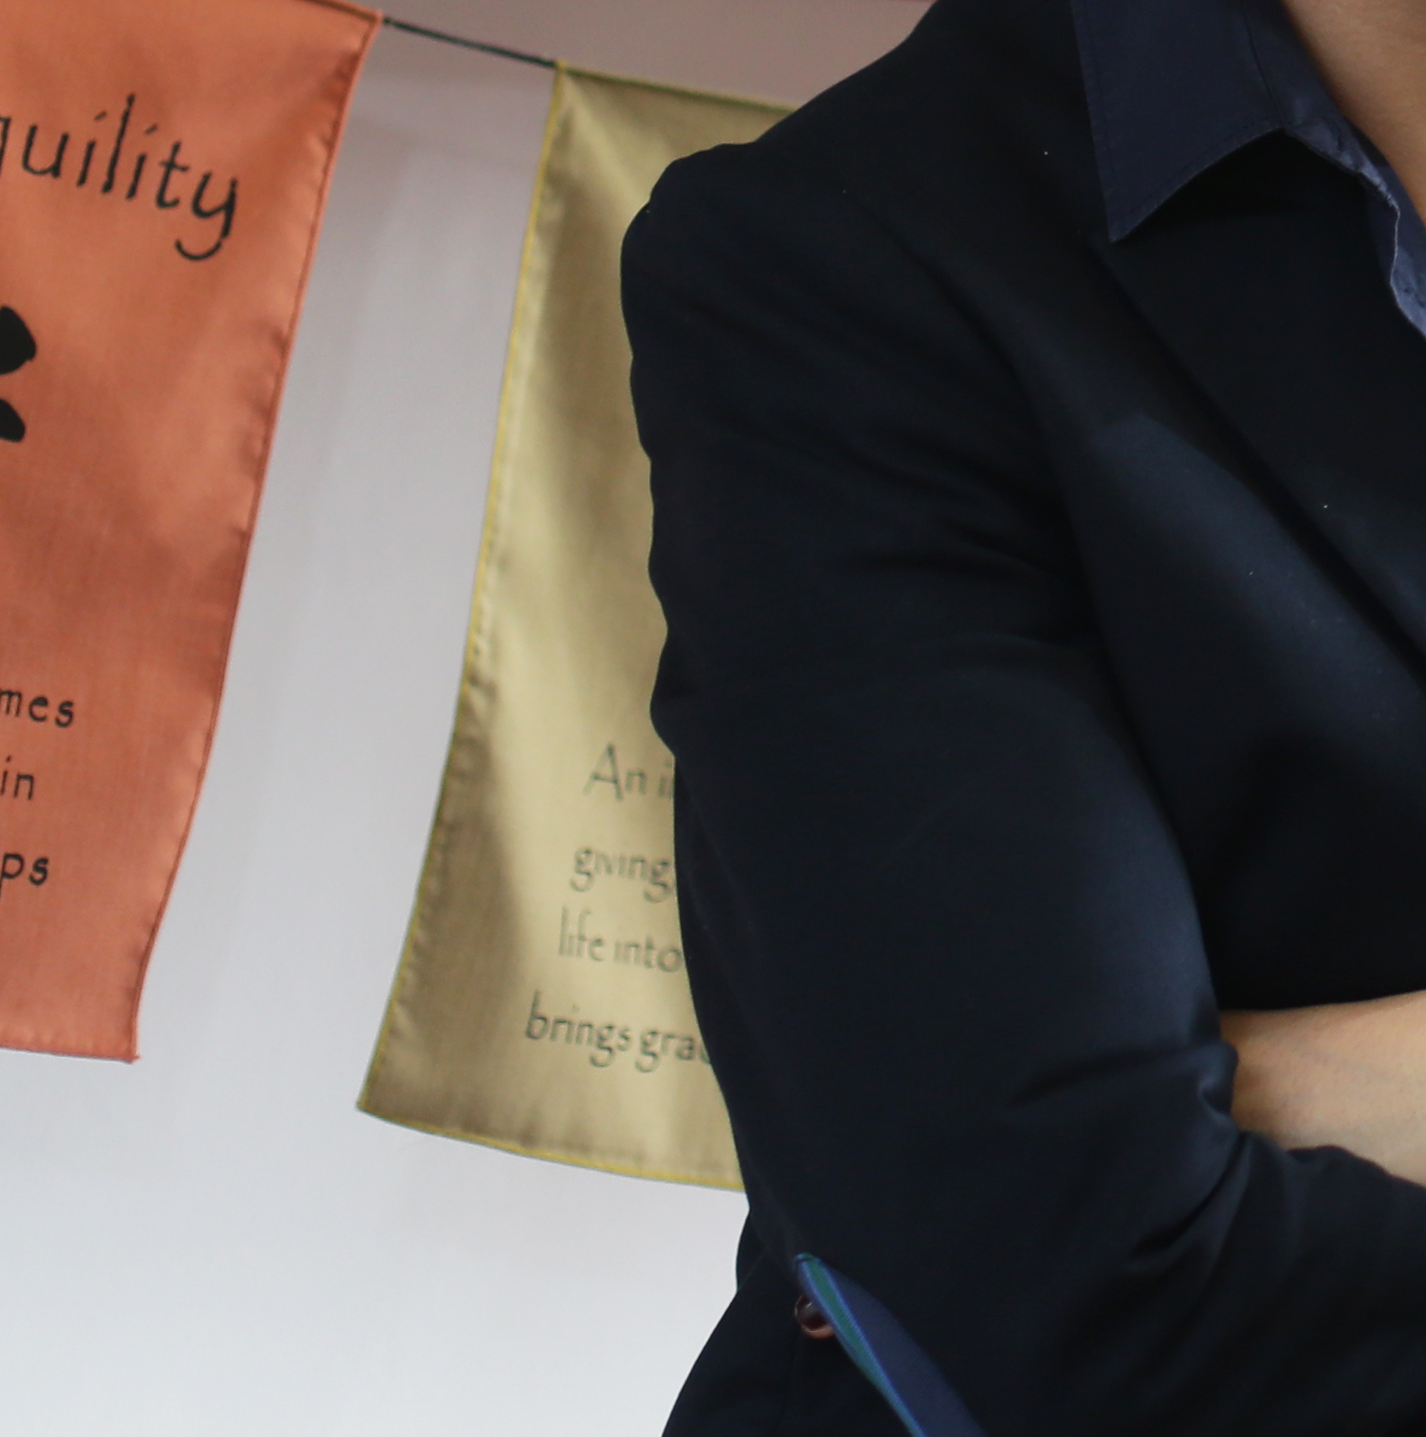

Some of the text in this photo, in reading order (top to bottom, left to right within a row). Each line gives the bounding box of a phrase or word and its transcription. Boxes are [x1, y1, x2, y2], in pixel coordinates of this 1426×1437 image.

[582, 741, 646, 802] An
[569, 846, 673, 904] giving
[558, 906, 685, 973] life into
[525, 990, 631, 1068] brings
